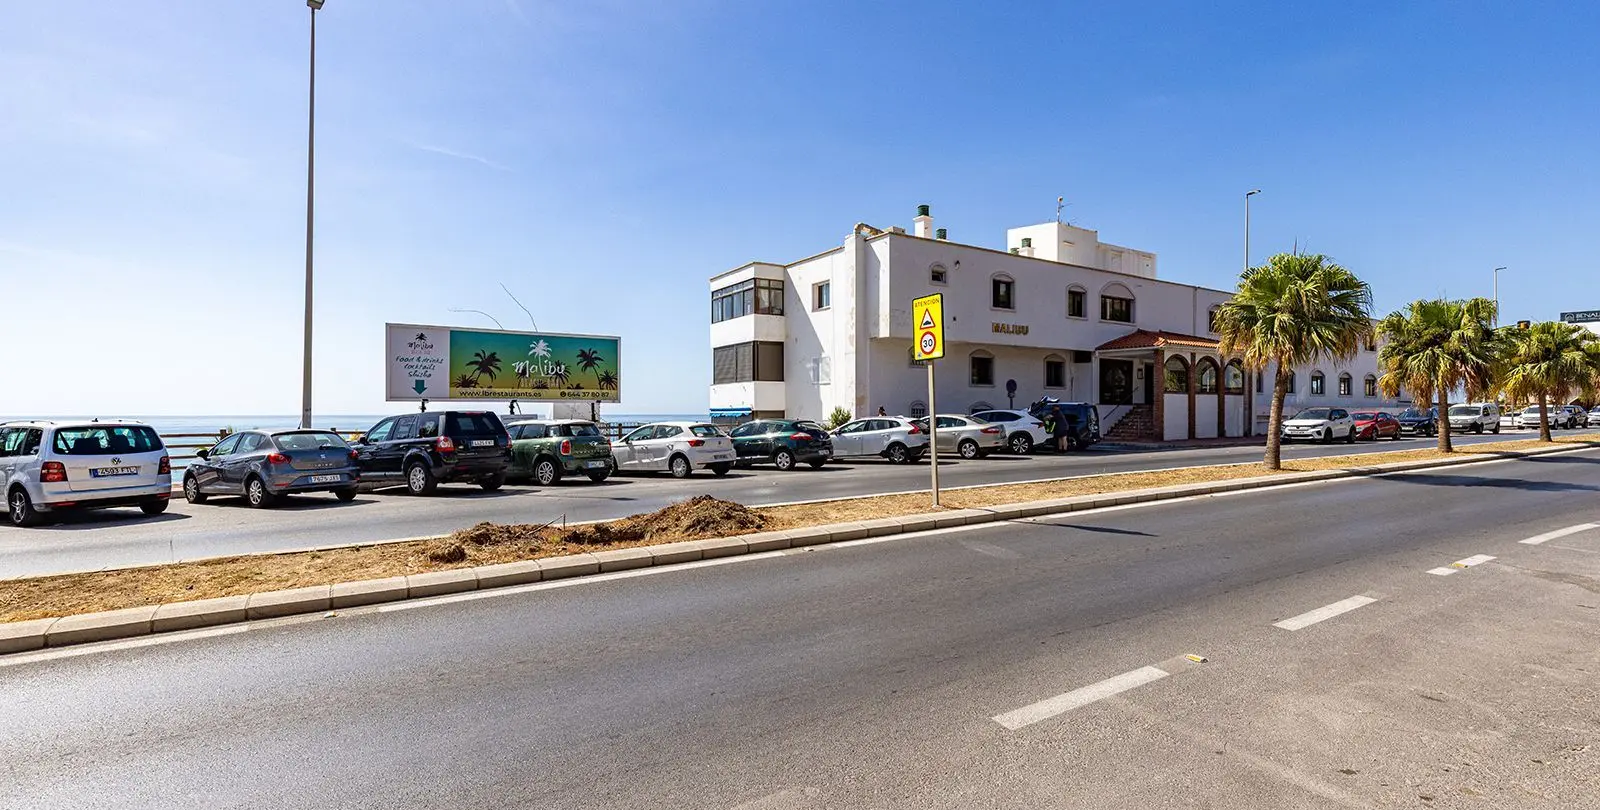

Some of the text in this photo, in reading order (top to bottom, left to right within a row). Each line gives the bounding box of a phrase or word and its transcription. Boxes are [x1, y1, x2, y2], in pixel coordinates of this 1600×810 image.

[991, 322, 1029, 335] MALIBU
[922, 338, 933, 348] 30
[512, 357, 566, 377] Malibu
[459, 390, 542, 398] www.lbrestaurants.es
